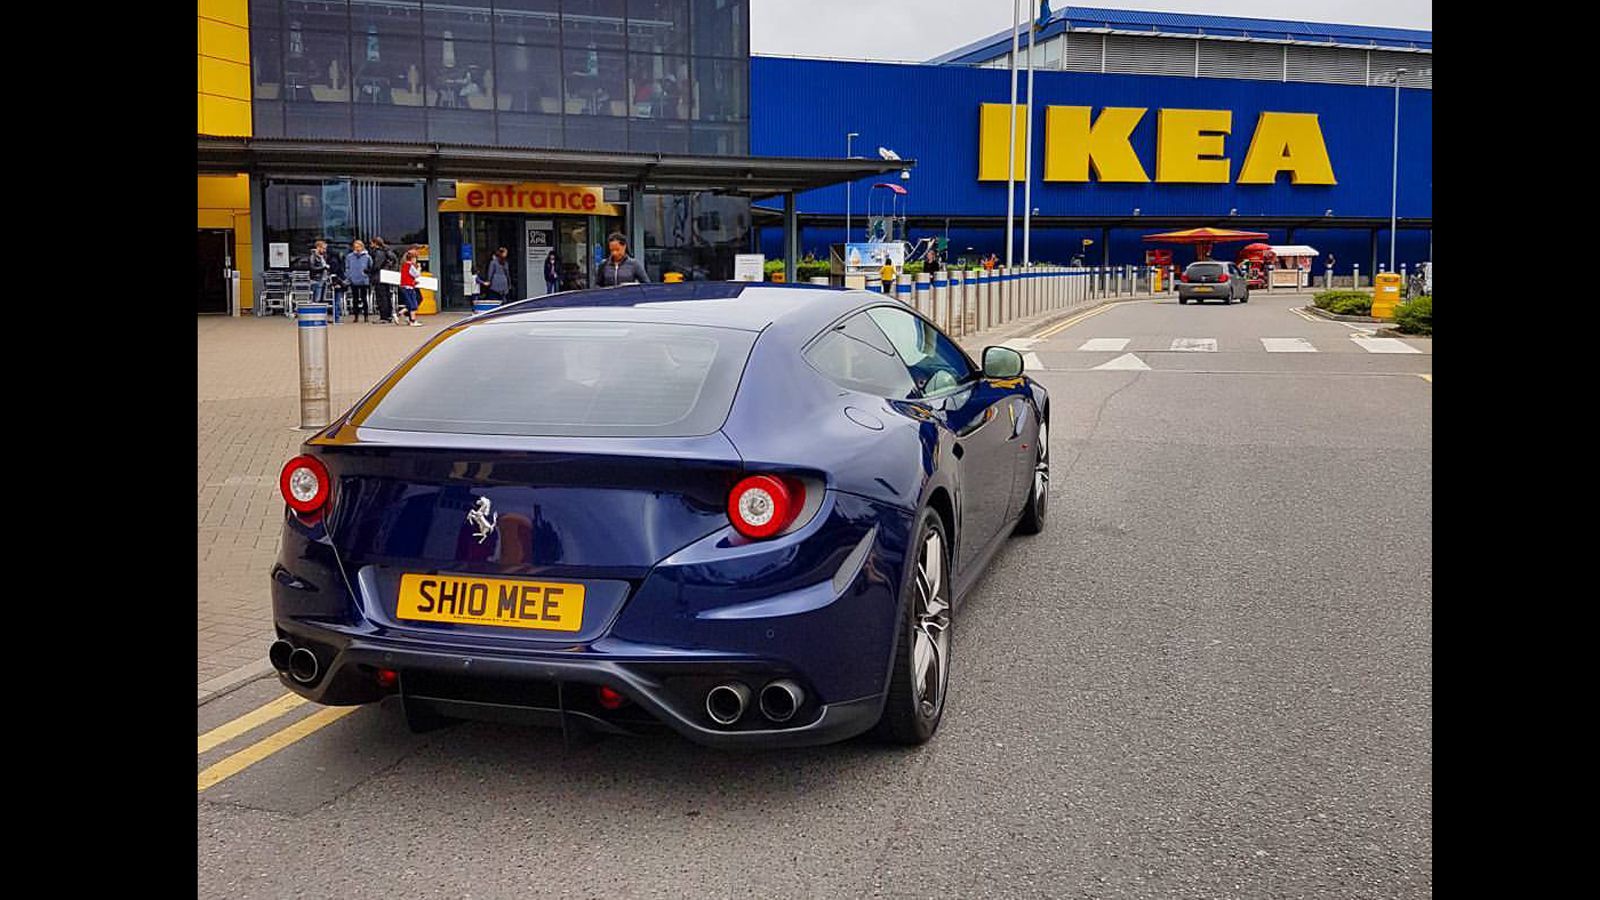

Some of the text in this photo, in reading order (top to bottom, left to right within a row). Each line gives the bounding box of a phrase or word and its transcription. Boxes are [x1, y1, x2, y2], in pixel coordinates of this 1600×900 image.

[978, 102, 1337, 184] IKEA
[466, 185, 597, 210] entrance
[496, 584, 564, 622] MEE
